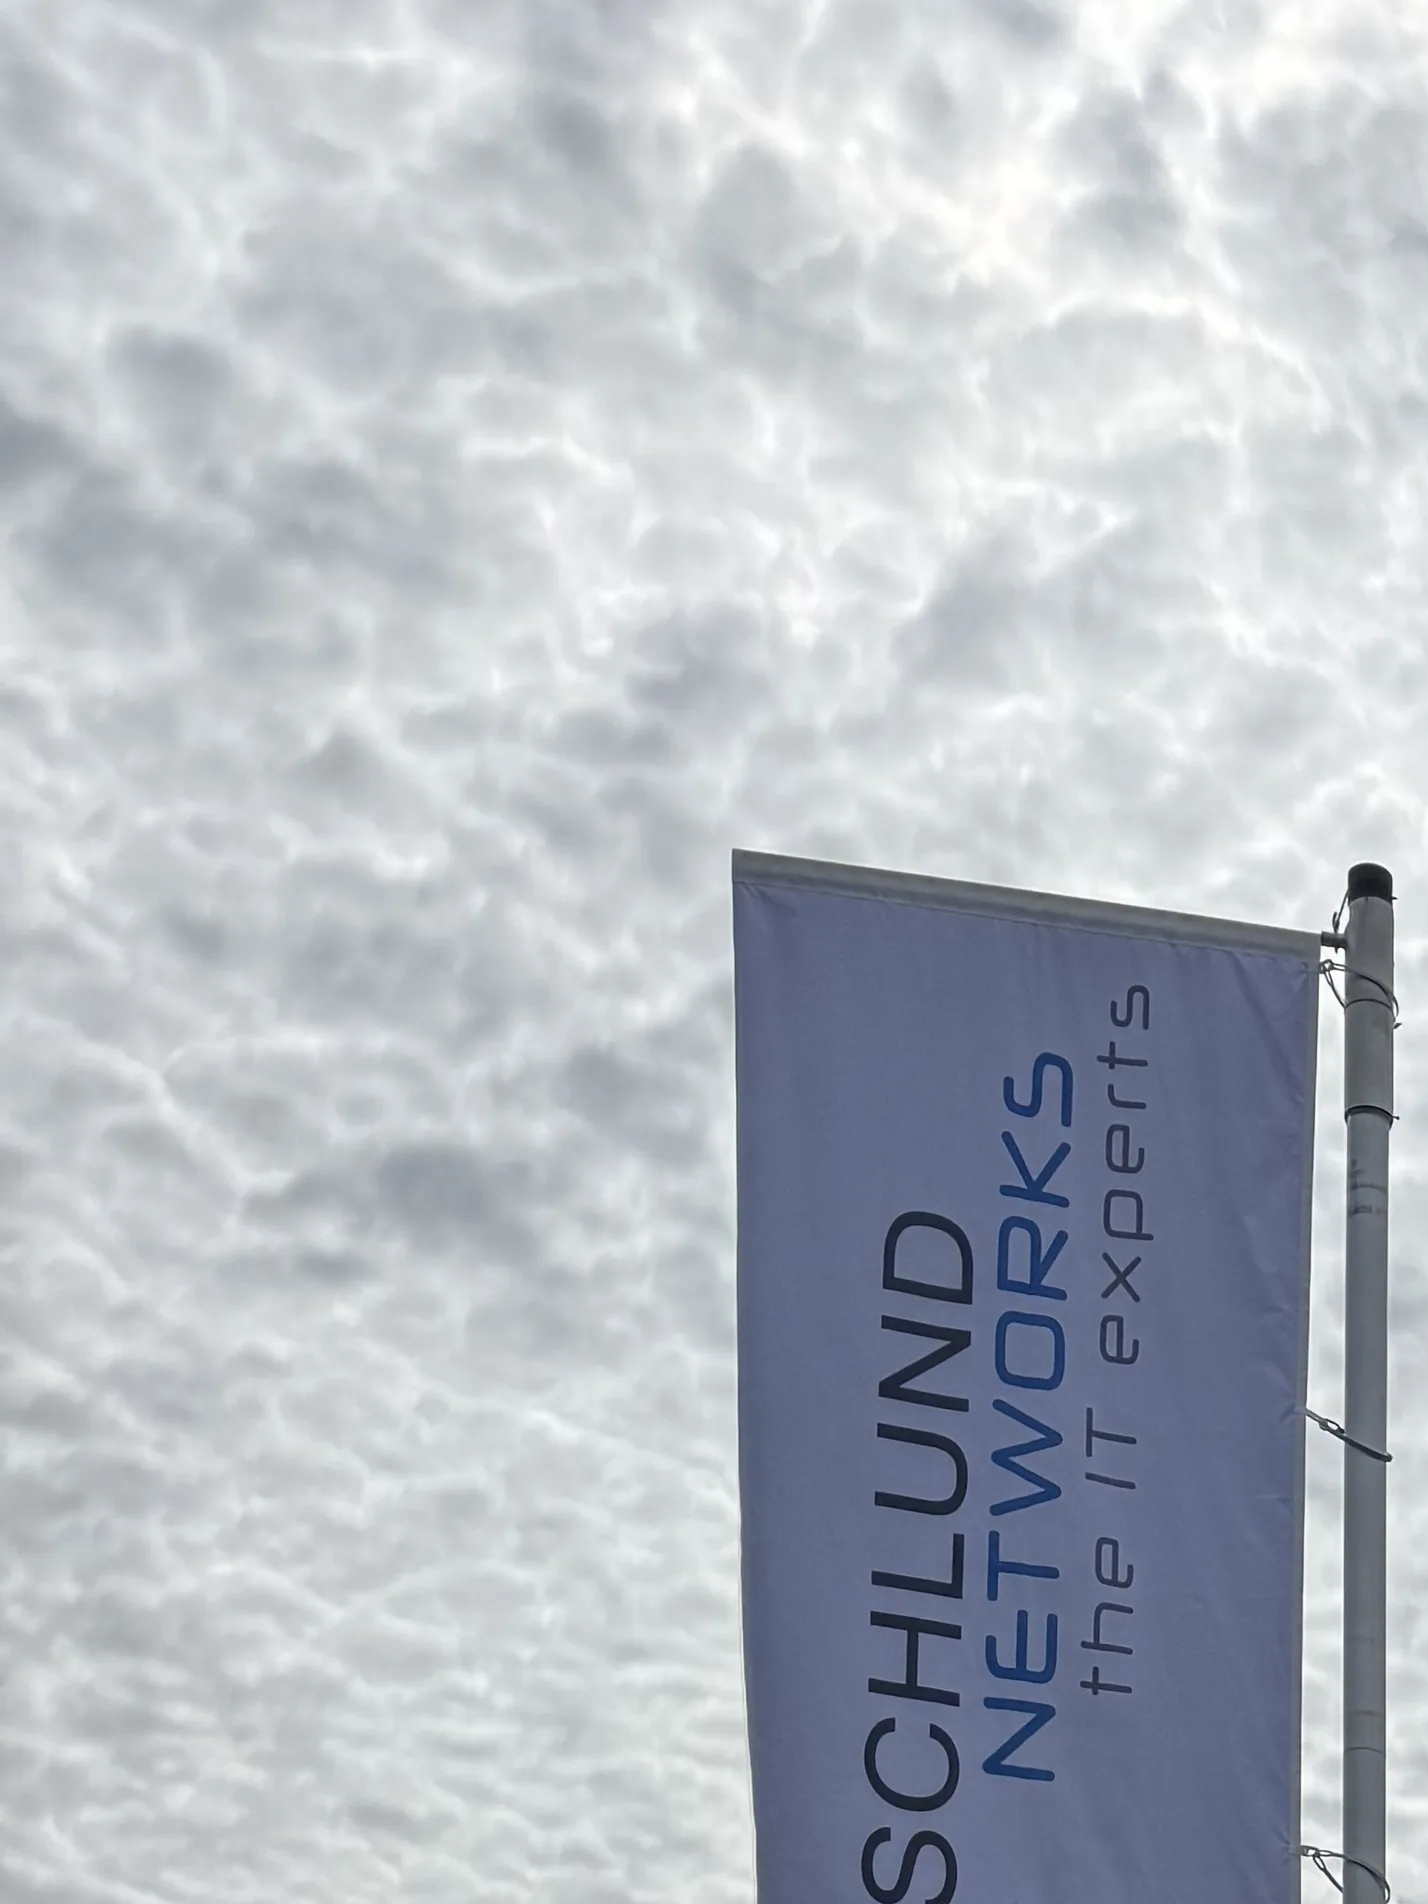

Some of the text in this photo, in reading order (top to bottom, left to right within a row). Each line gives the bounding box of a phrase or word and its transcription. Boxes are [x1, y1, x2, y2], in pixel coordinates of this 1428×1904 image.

[982, 1053, 1073, 1781] NETWORKS
[1080, 985, 1154, 1695] the IT experts
